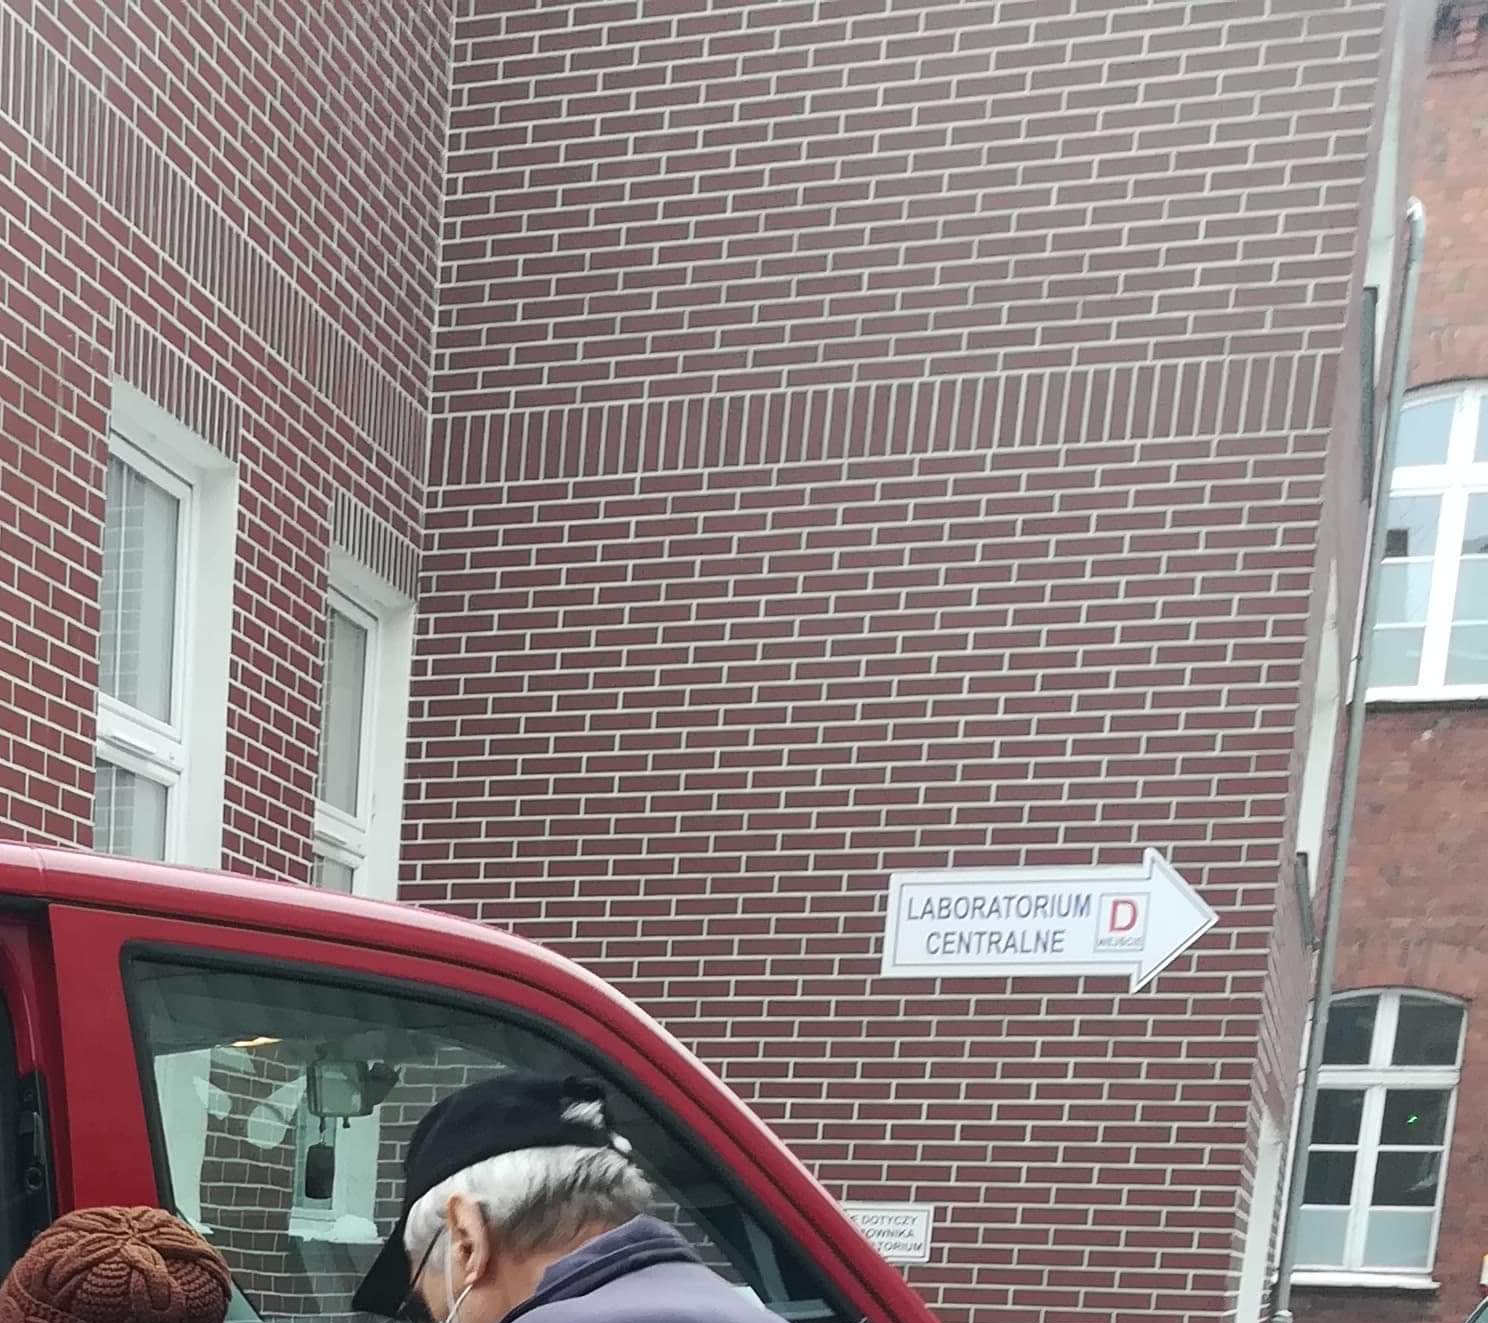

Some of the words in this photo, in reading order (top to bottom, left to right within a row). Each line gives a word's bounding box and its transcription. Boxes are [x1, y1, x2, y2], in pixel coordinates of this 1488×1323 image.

[907, 893, 1093, 920] LABORATORIUM
[1109, 898, 1138, 933] D
[926, 930, 1065, 955] CENTRALNE
